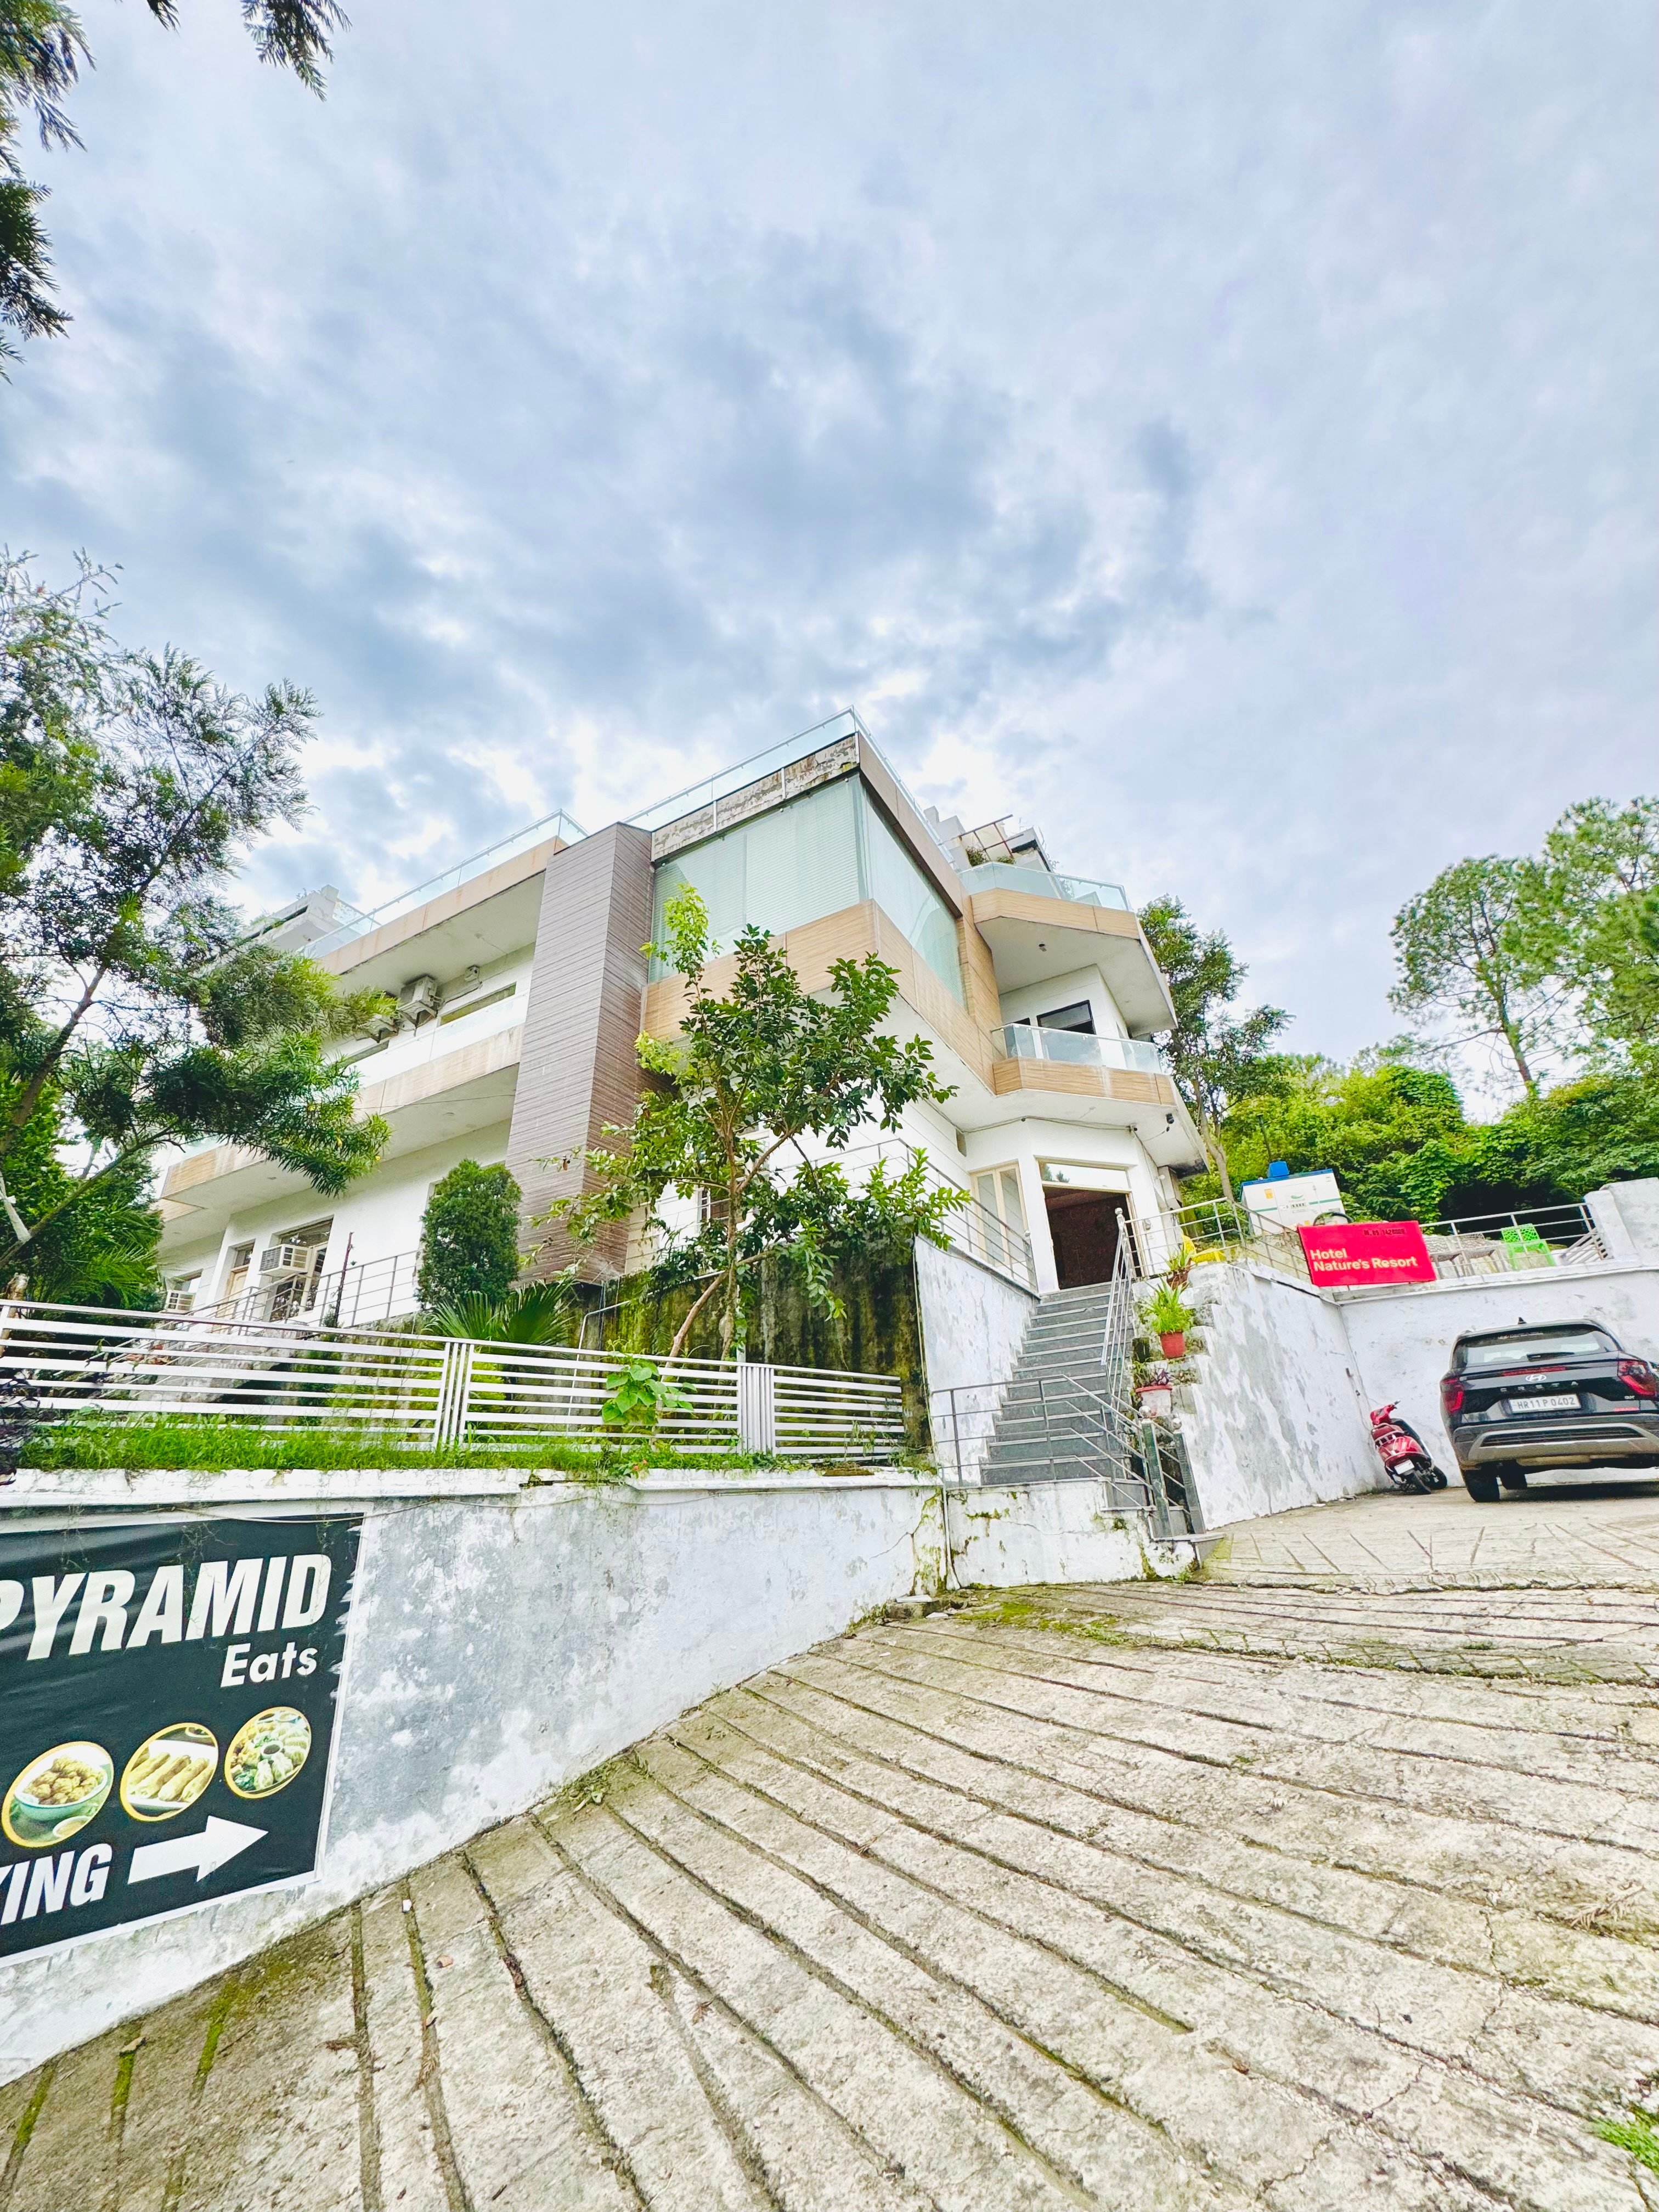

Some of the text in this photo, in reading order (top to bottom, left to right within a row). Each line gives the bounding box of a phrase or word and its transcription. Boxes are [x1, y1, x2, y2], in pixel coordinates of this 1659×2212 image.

[1310, 1248, 1347, 1260] Hotel
[1313, 1256, 1418, 1272] Nature's Resort
[220, 1641, 318, 1688] Eats
[0, 1843, 112, 1926] ING
